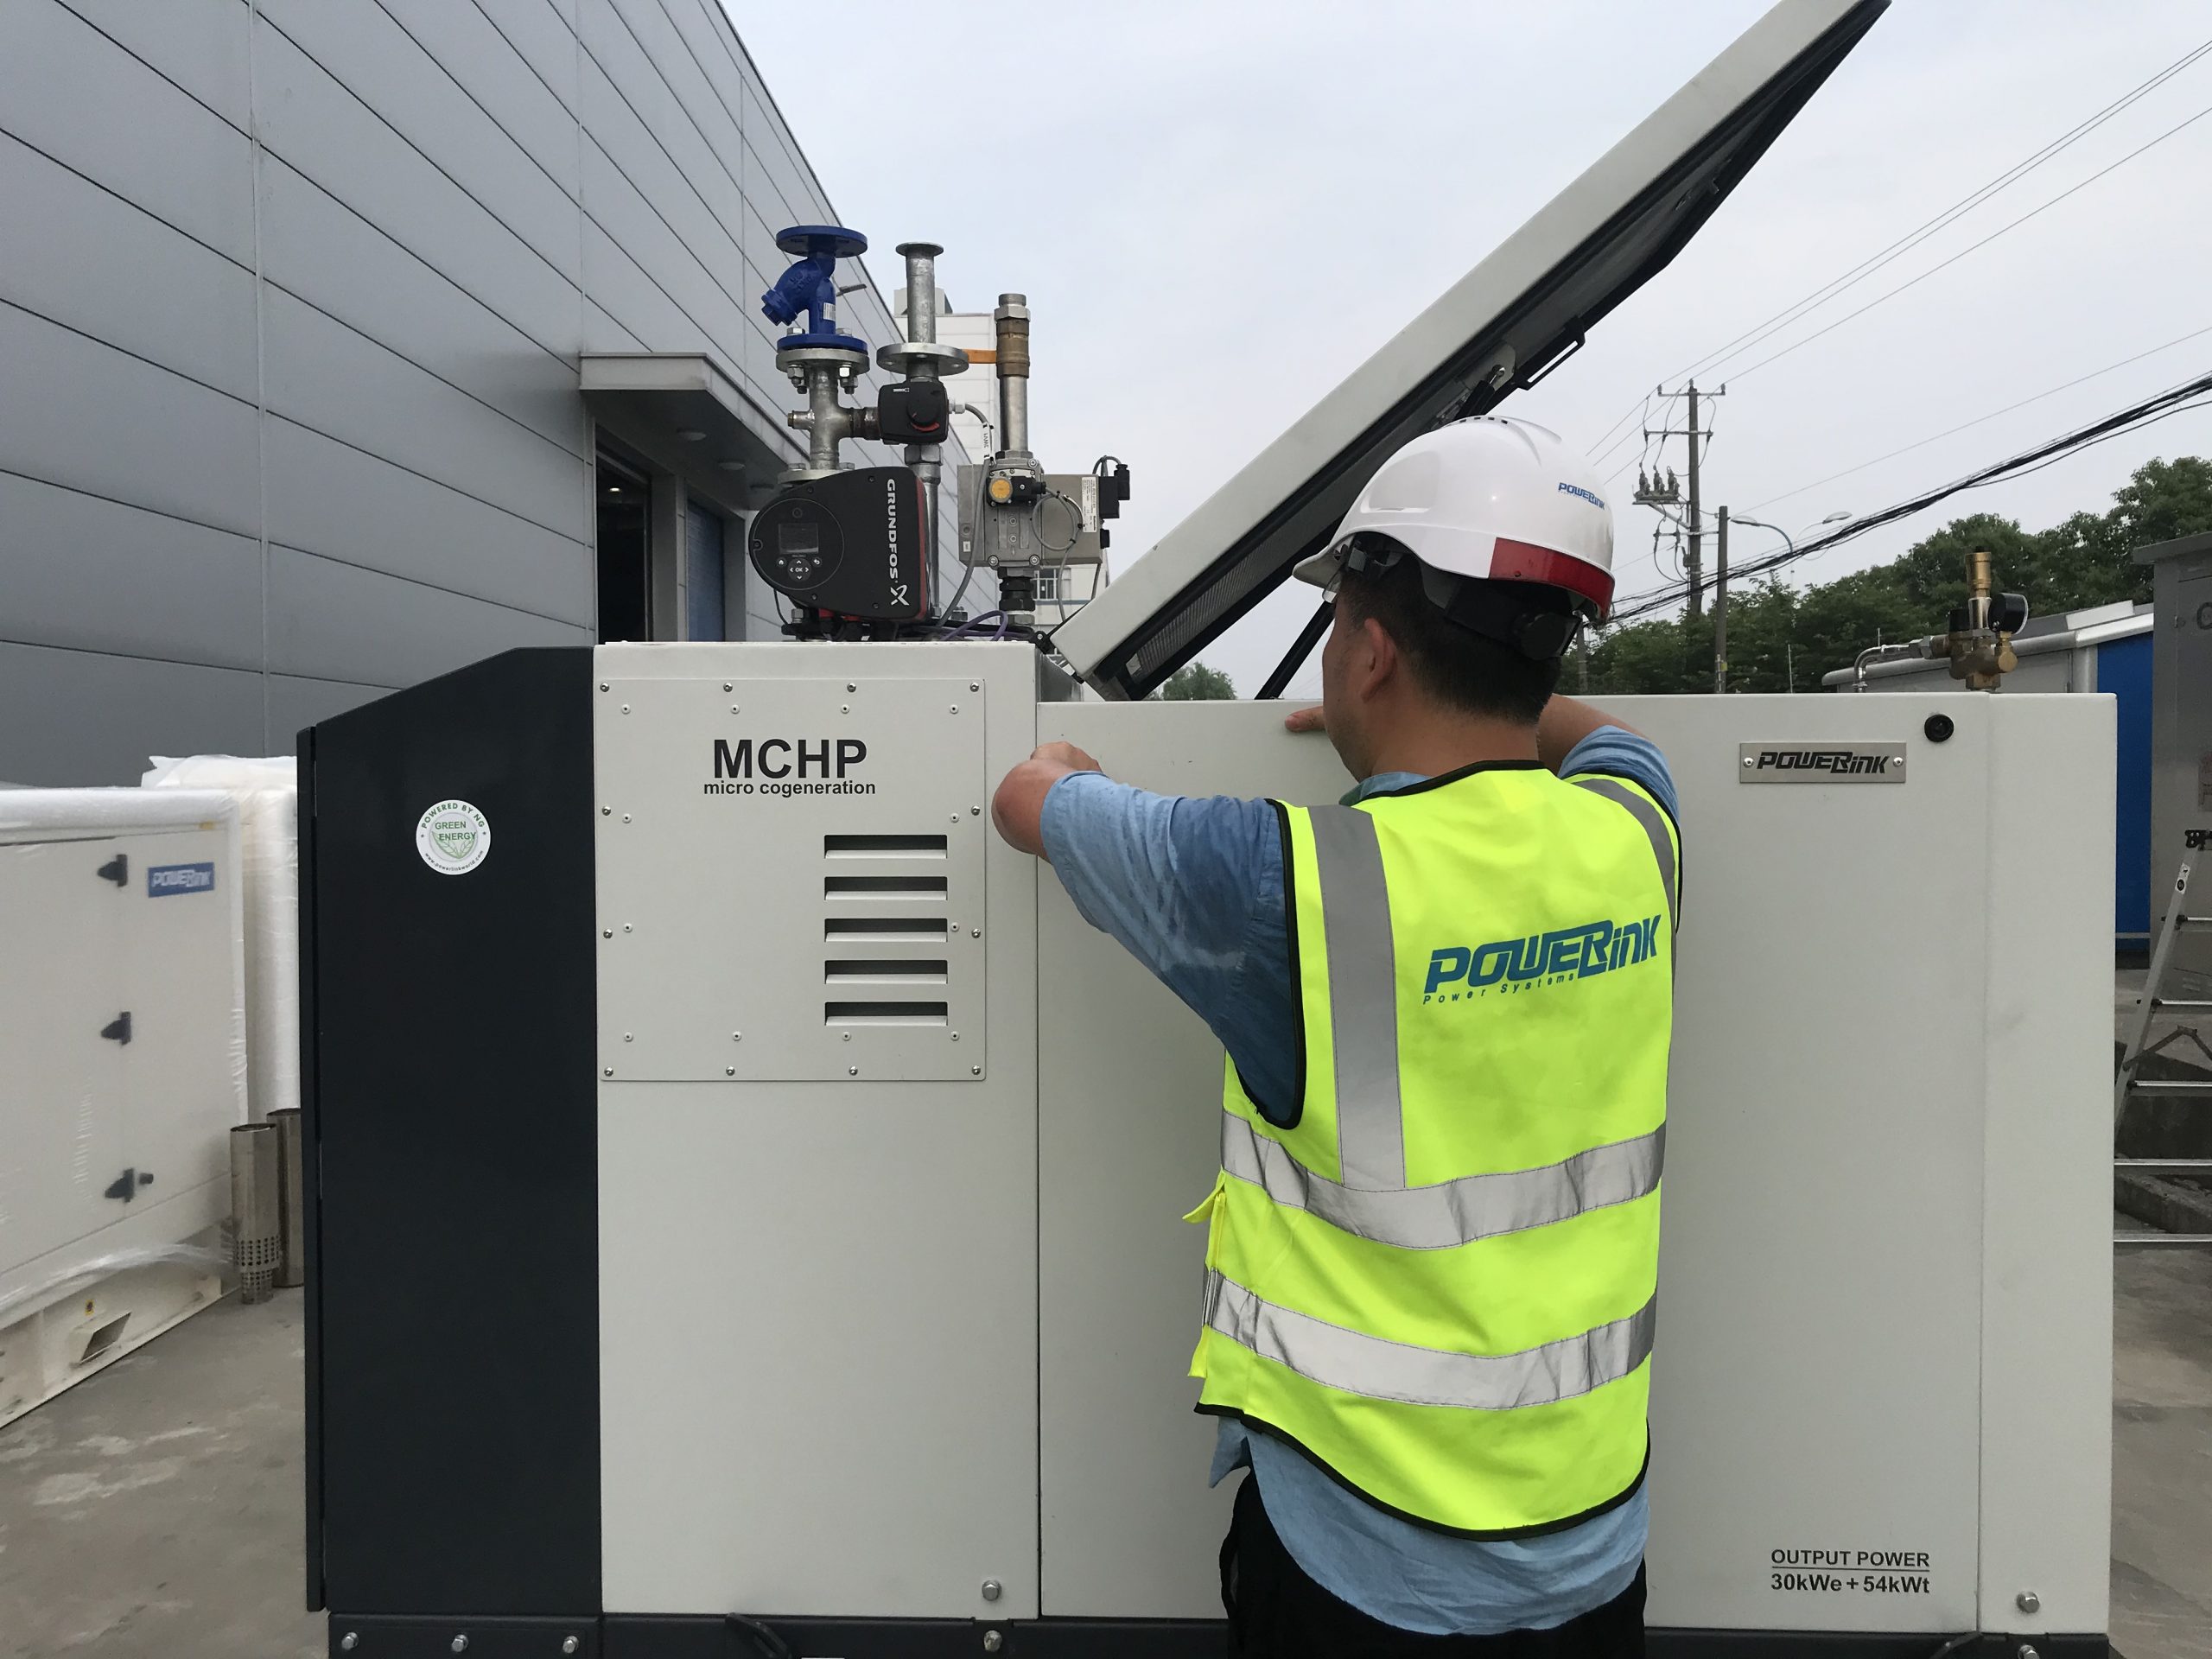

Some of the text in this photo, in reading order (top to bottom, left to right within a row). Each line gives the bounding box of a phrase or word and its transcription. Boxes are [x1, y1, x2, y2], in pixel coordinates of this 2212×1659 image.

[887, 479, 899, 580] GRUNDFOS
[714, 739, 868, 779] MCHP
[703, 780, 876, 798] micro cogeneration
[421, 803, 486, 830] POWERED BY NG
[435, 821, 467, 830] GREEN
[438, 831, 476, 841] ENERGY
[1423, 972, 1574, 1005] Power Systems
[1771, 1549, 1930, 1567] OUTPUT POWER
